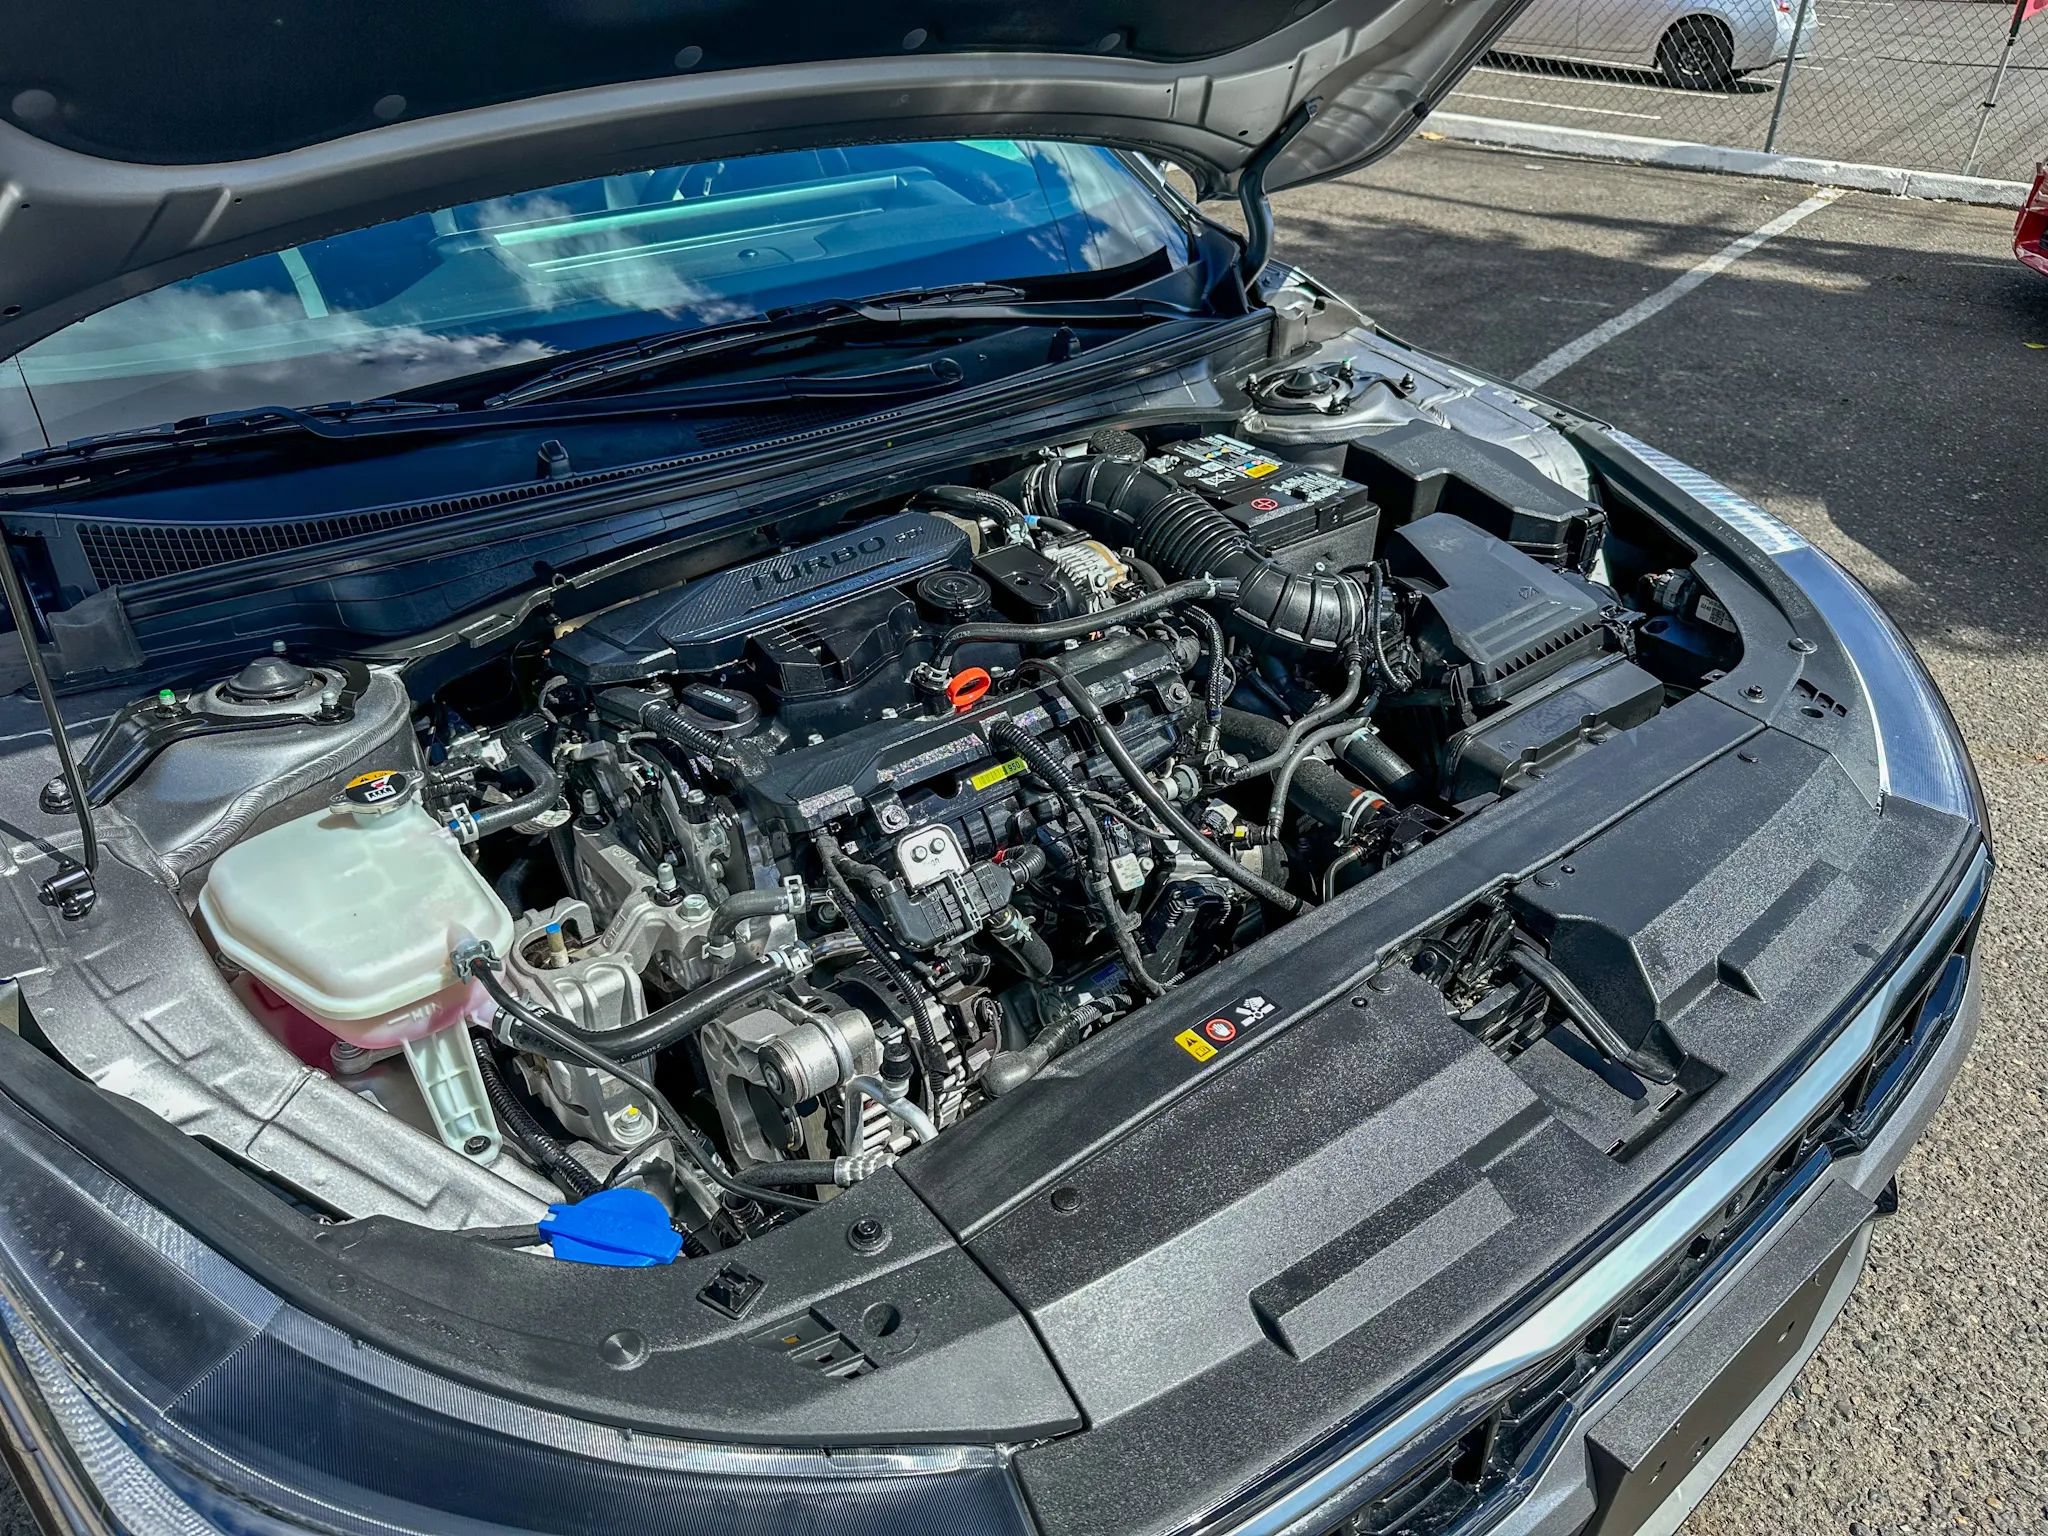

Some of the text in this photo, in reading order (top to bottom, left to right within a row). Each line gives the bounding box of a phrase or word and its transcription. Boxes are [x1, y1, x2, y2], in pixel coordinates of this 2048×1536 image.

[741, 536, 886, 592] TURBO
[1008, 761, 1021, 772] 950
[410, 1002, 444, 1022] MIN
